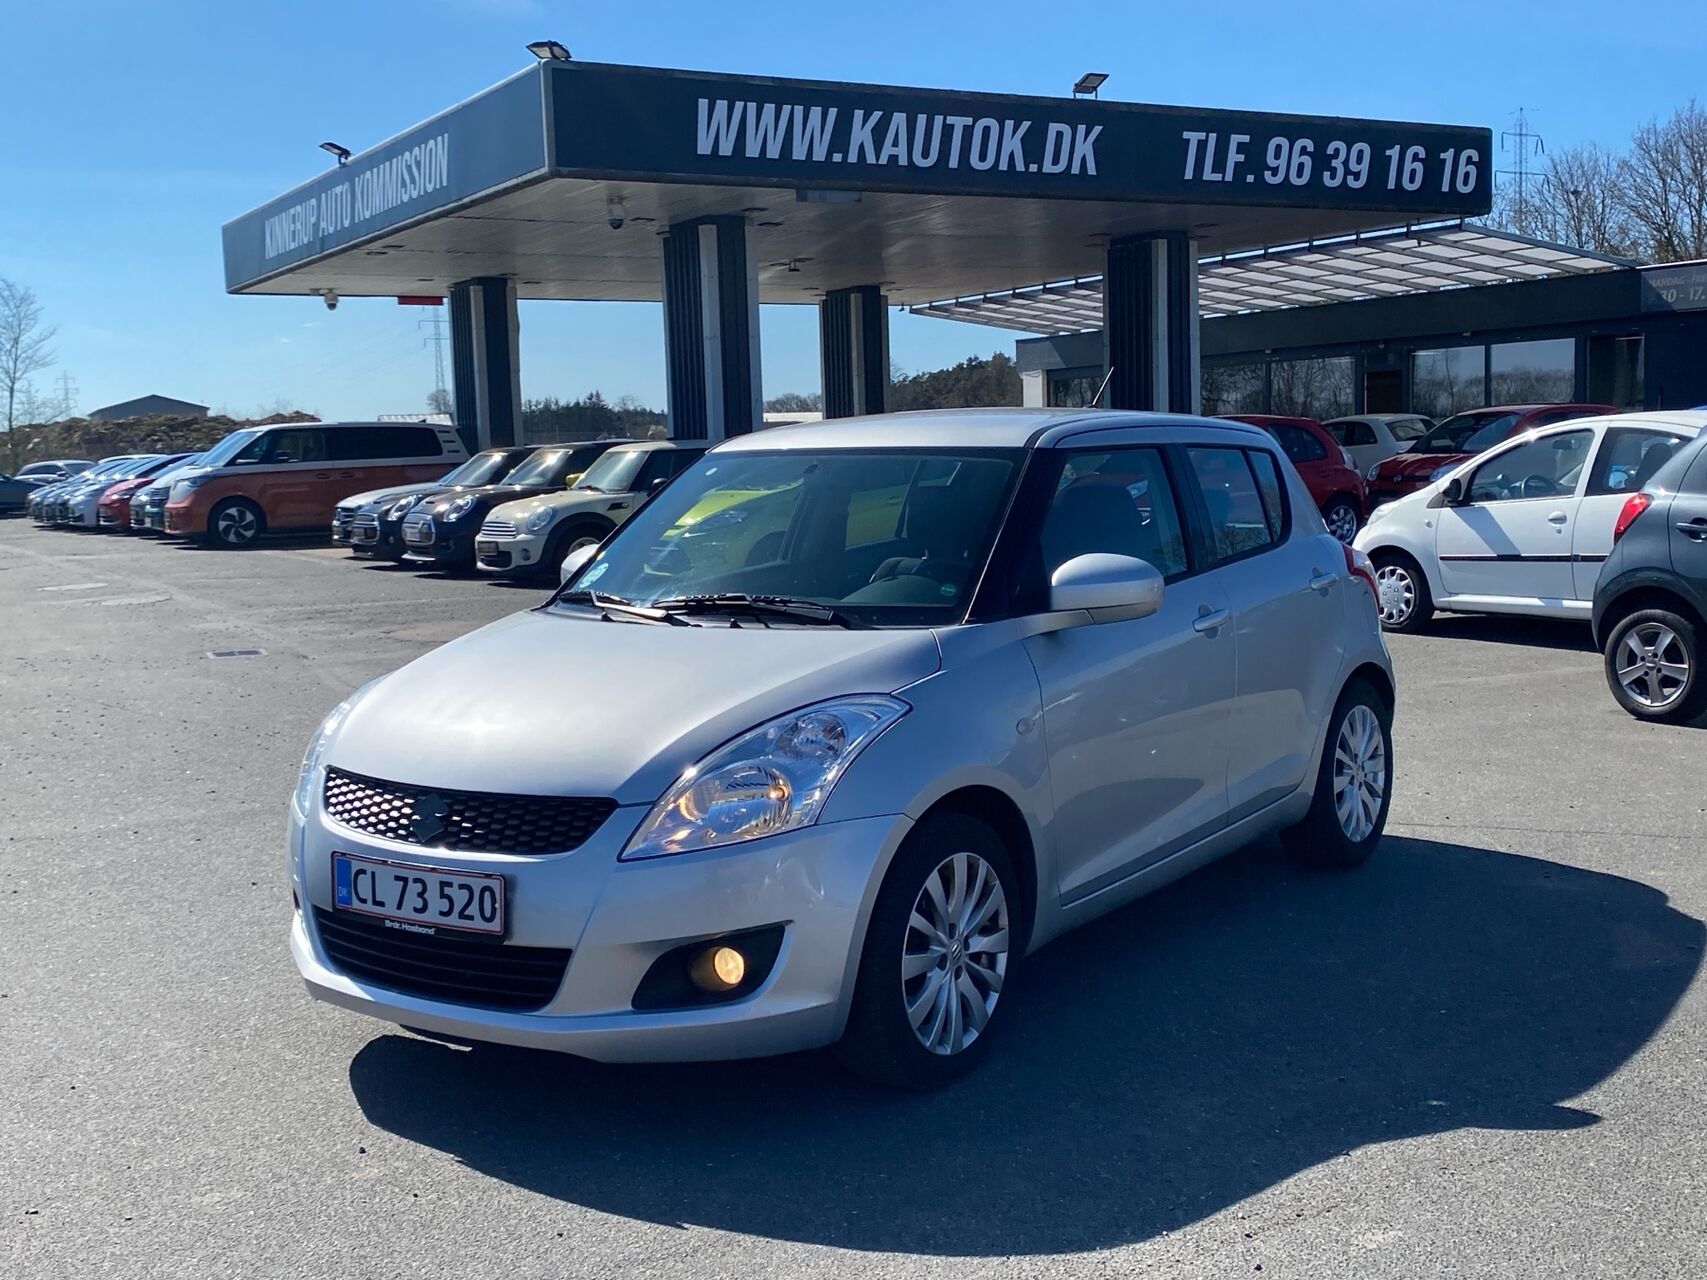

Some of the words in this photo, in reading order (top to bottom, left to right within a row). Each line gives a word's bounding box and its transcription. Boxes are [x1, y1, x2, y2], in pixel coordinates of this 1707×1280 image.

[697, 98, 1103, 176] WWW.KAUTOK.DK
[1182, 131, 1255, 183] TLF.
[1264, 136, 1314, 186] 96
[1323, 140, 1371, 189] 39
[1385, 144, 1426, 191] 16
[1439, 148, 1479, 194] 16
[265, 198, 317, 260] KINNERUP
[319, 181, 351, 238] AUTO
[354, 133, 448, 223] KOMMISSION
[338, 886, 348, 898] DK
[353, 868, 385, 907] CL
[394, 875, 428, 914] 73
[438, 880, 498, 923] 520
